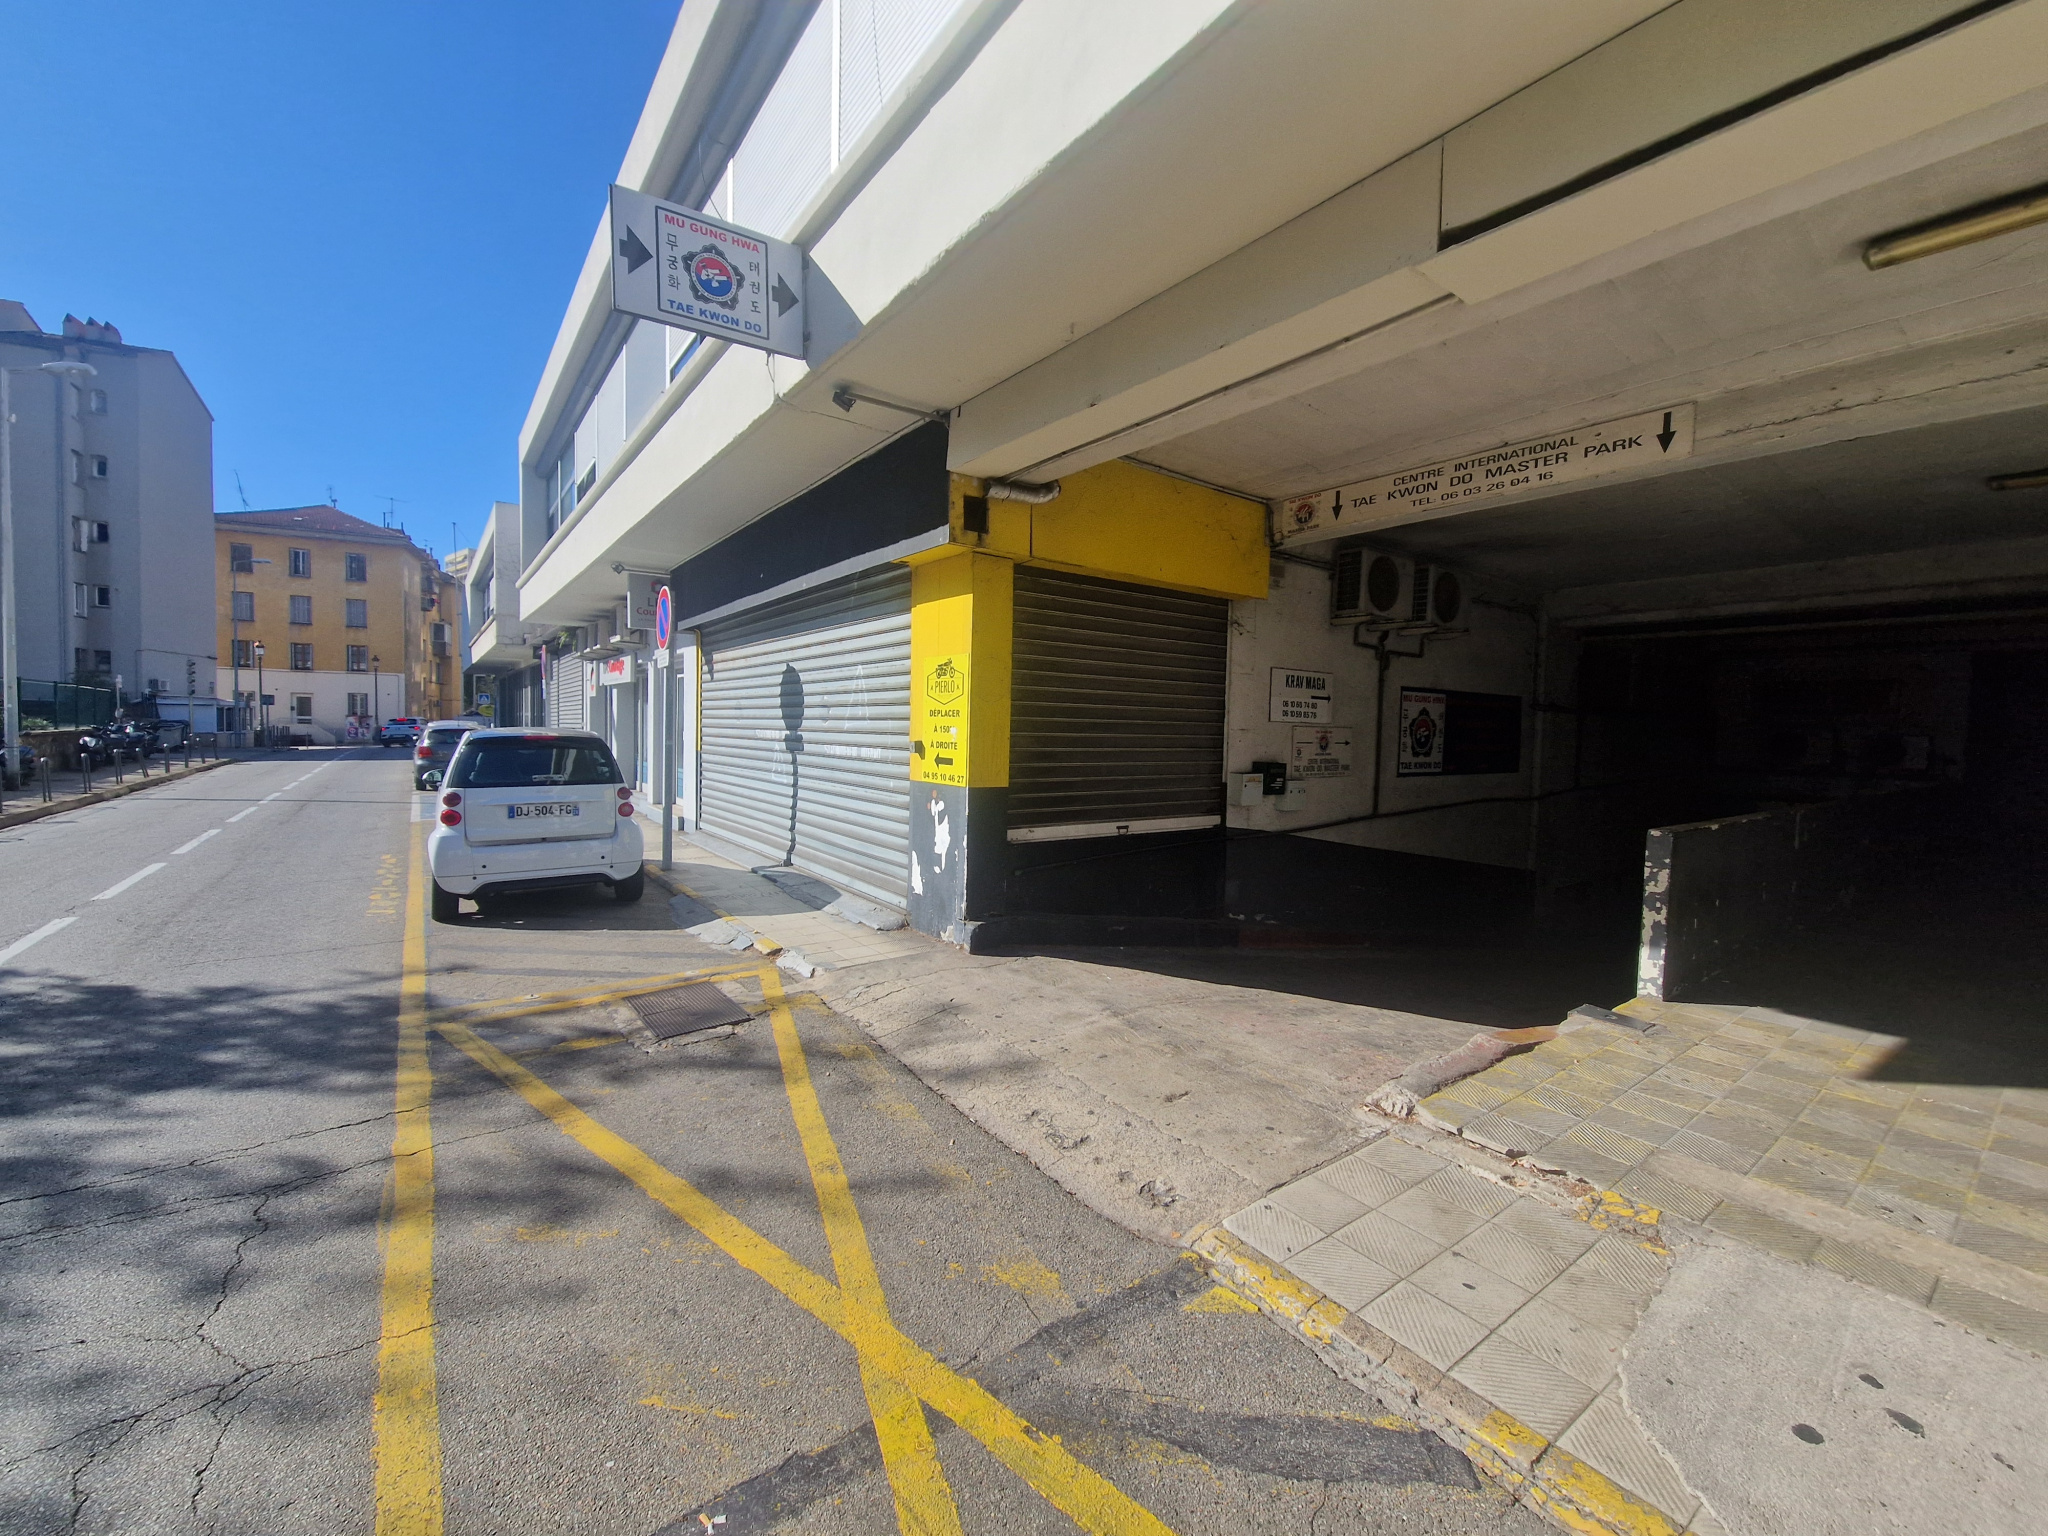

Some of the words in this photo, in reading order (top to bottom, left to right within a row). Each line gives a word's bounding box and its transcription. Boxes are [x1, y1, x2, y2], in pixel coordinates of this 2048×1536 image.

[664, 214, 685, 229] MU
[690, 223, 728, 242] GUNG
[731, 236, 760, 254] HWA
[667, 299, 694, 315] TAE
[699, 307, 740, 327] KWON
[744, 320, 762, 333] DO
[1393, 466, 1445, 487] CENTRE
[1453, 436, 1580, 472] INTERNATIONAL
[1350, 494, 1377, 509] TAE
[1387, 480, 1438, 502] KWON
[1450, 471, 1474, 488] DO
[1485, 452, 1568, 479] MASTER
[1584, 434, 1644, 459] PARK
[1440, 490, 1460, 501] 06
[1463, 486, 1482, 497] 03
[1486, 481, 1505, 492] 26
[1510, 476, 1531, 487] 04
[1537, 471, 1554, 481] 16
[934, 679, 956, 694] PIERLO
[1285, 674, 1304, 688] KRAV
[1305, 677, 1326, 691] MAGA
[929, 708, 961, 718] DÉPLACER
[936, 741, 958, 750] DROITE
[923, 771, 930, 779] 04
[931, 772, 939, 780] 95
[940, 773, 947, 782] 10
[948, 774, 955, 783] 46
[957, 775, 965, 784] 27
[516, 805, 572, 817] DJ-504-FG
